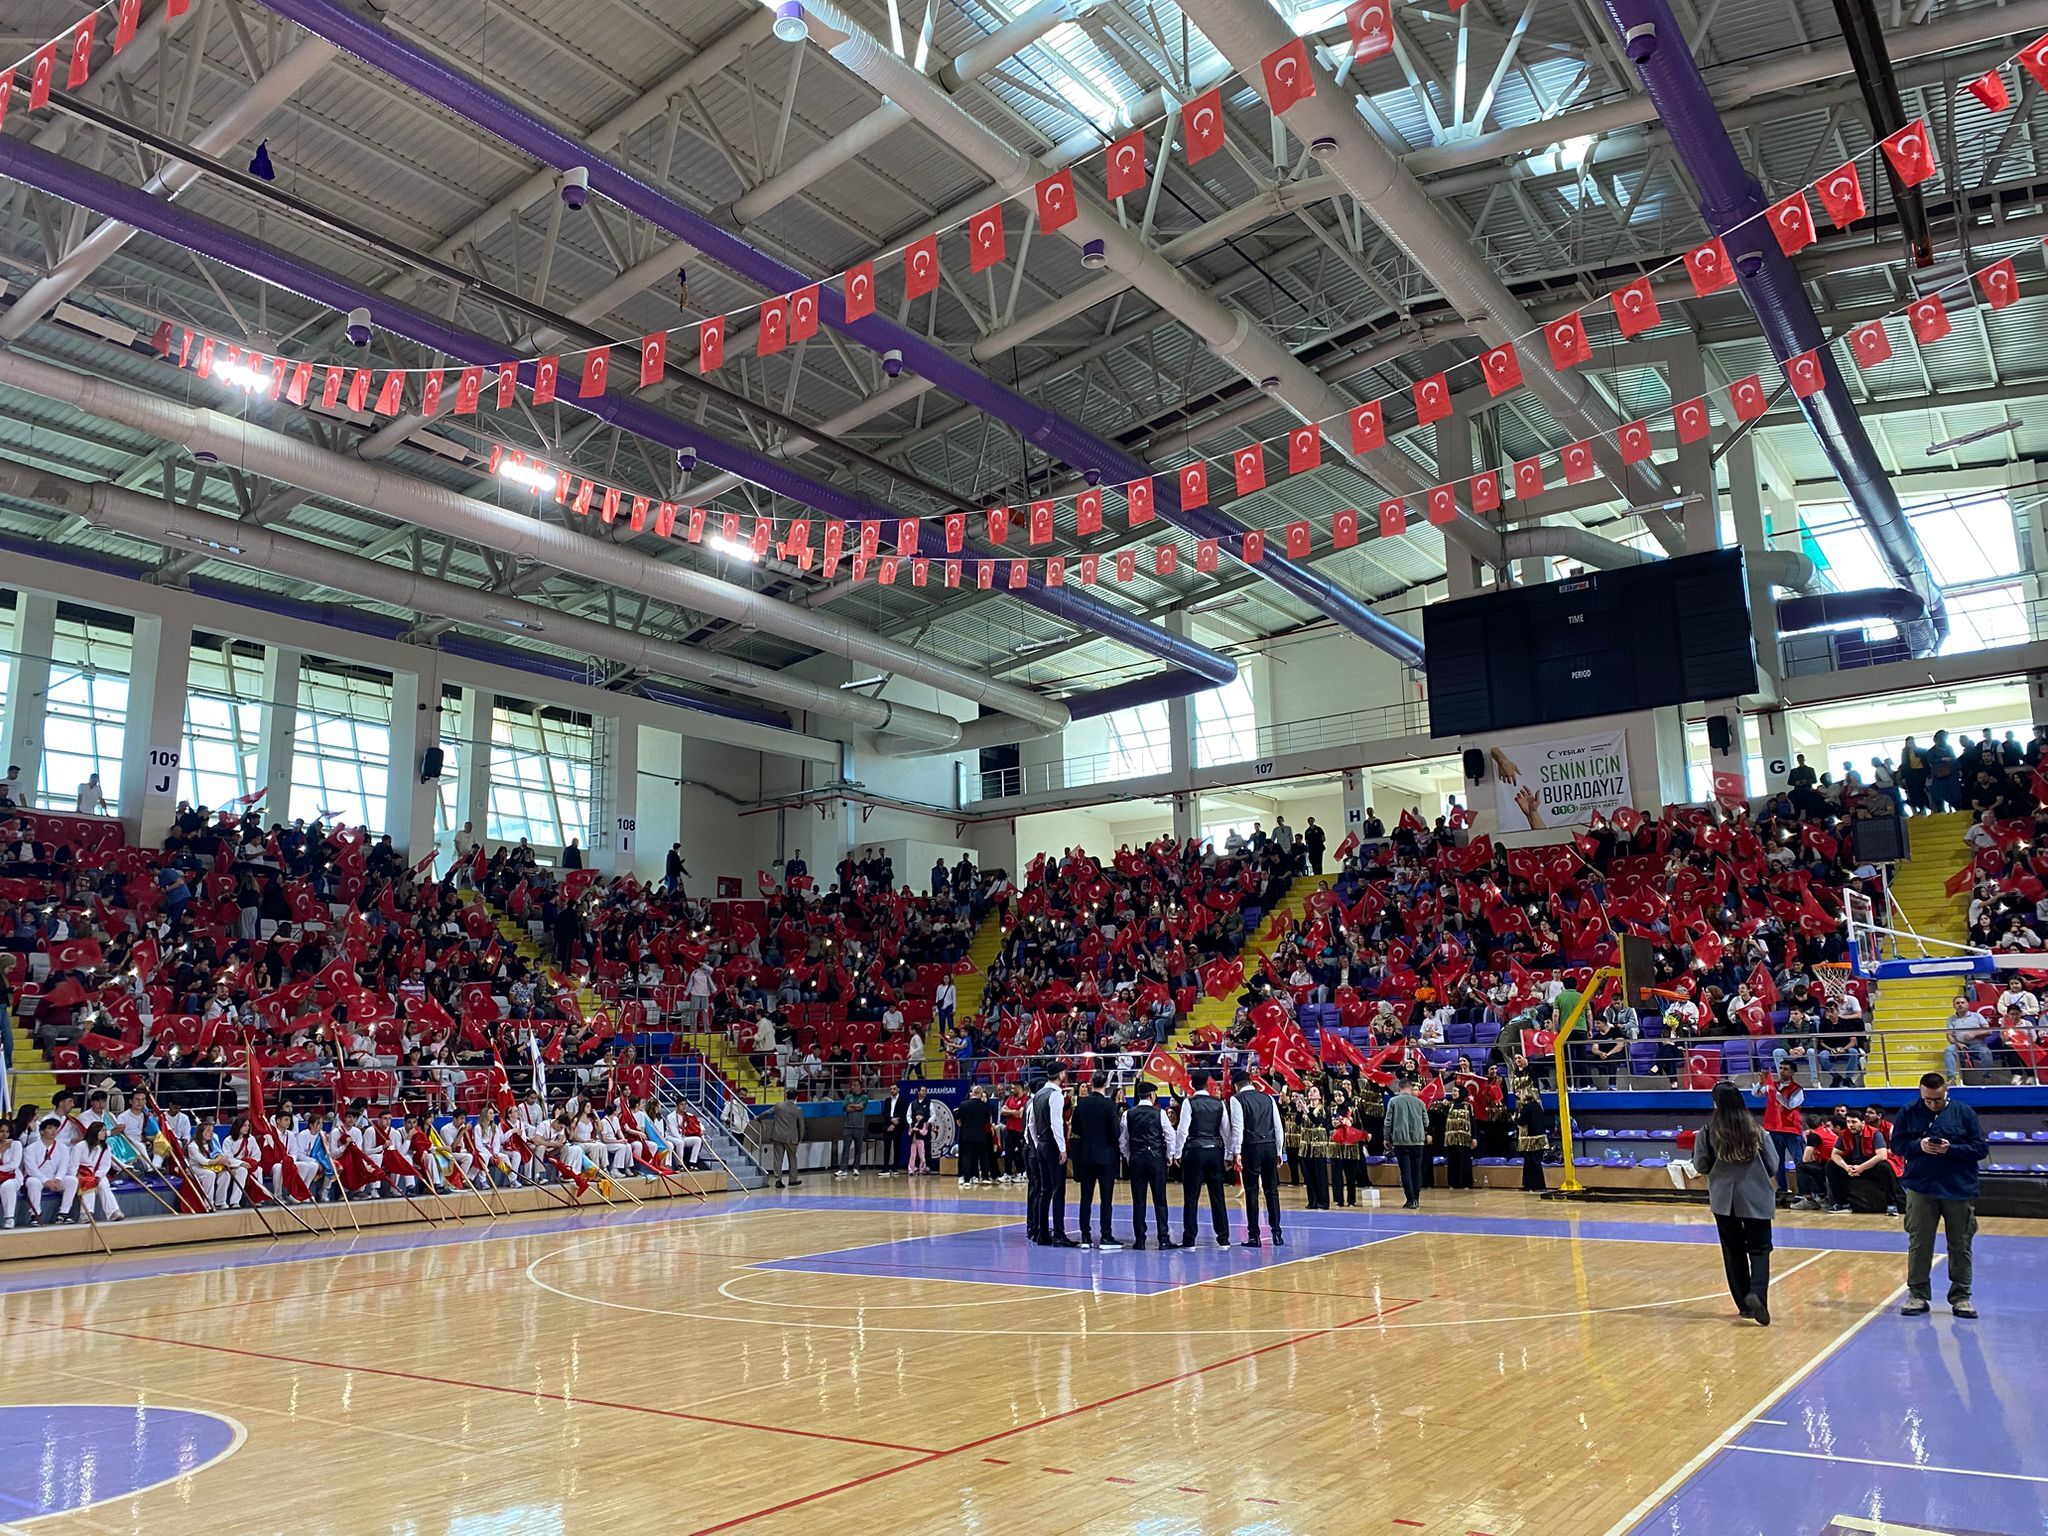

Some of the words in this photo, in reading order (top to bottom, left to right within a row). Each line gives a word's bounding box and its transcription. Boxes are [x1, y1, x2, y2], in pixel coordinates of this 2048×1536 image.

[1568, 613, 1584, 624] TIME
[1571, 669, 1592, 679] PERIOD
[150, 750, 179, 767] 109
[1255, 762, 1273, 775] 107
[1540, 759, 1586, 783] SENİN
[1589, 754, 1621, 778] İÇİN
[1770, 759, 1785, 774] G
[155, 775, 170, 792] J
[1543, 776, 1625, 805] BURADAYIZ
[1349, 809, 1361, 822] H
[617, 818, 635, 831] 108
[1541, 942, 1552, 952] 34
